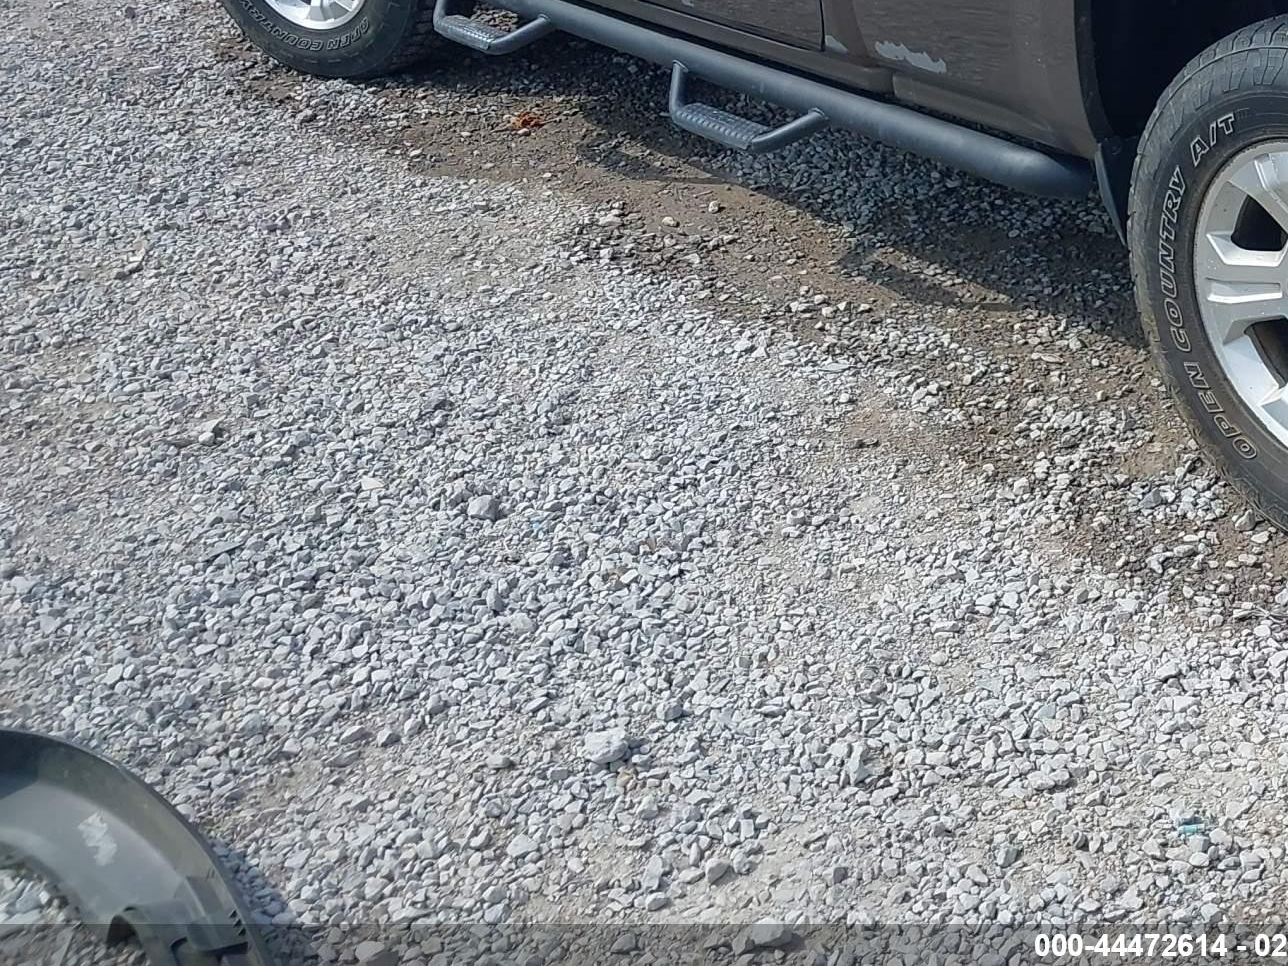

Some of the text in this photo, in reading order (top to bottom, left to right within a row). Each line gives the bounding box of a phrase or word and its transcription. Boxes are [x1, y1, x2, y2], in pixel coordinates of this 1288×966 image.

[327, 16, 369, 51] OPEN
[1157, 112, 1258, 461] OPEN COUNTRY A/T
